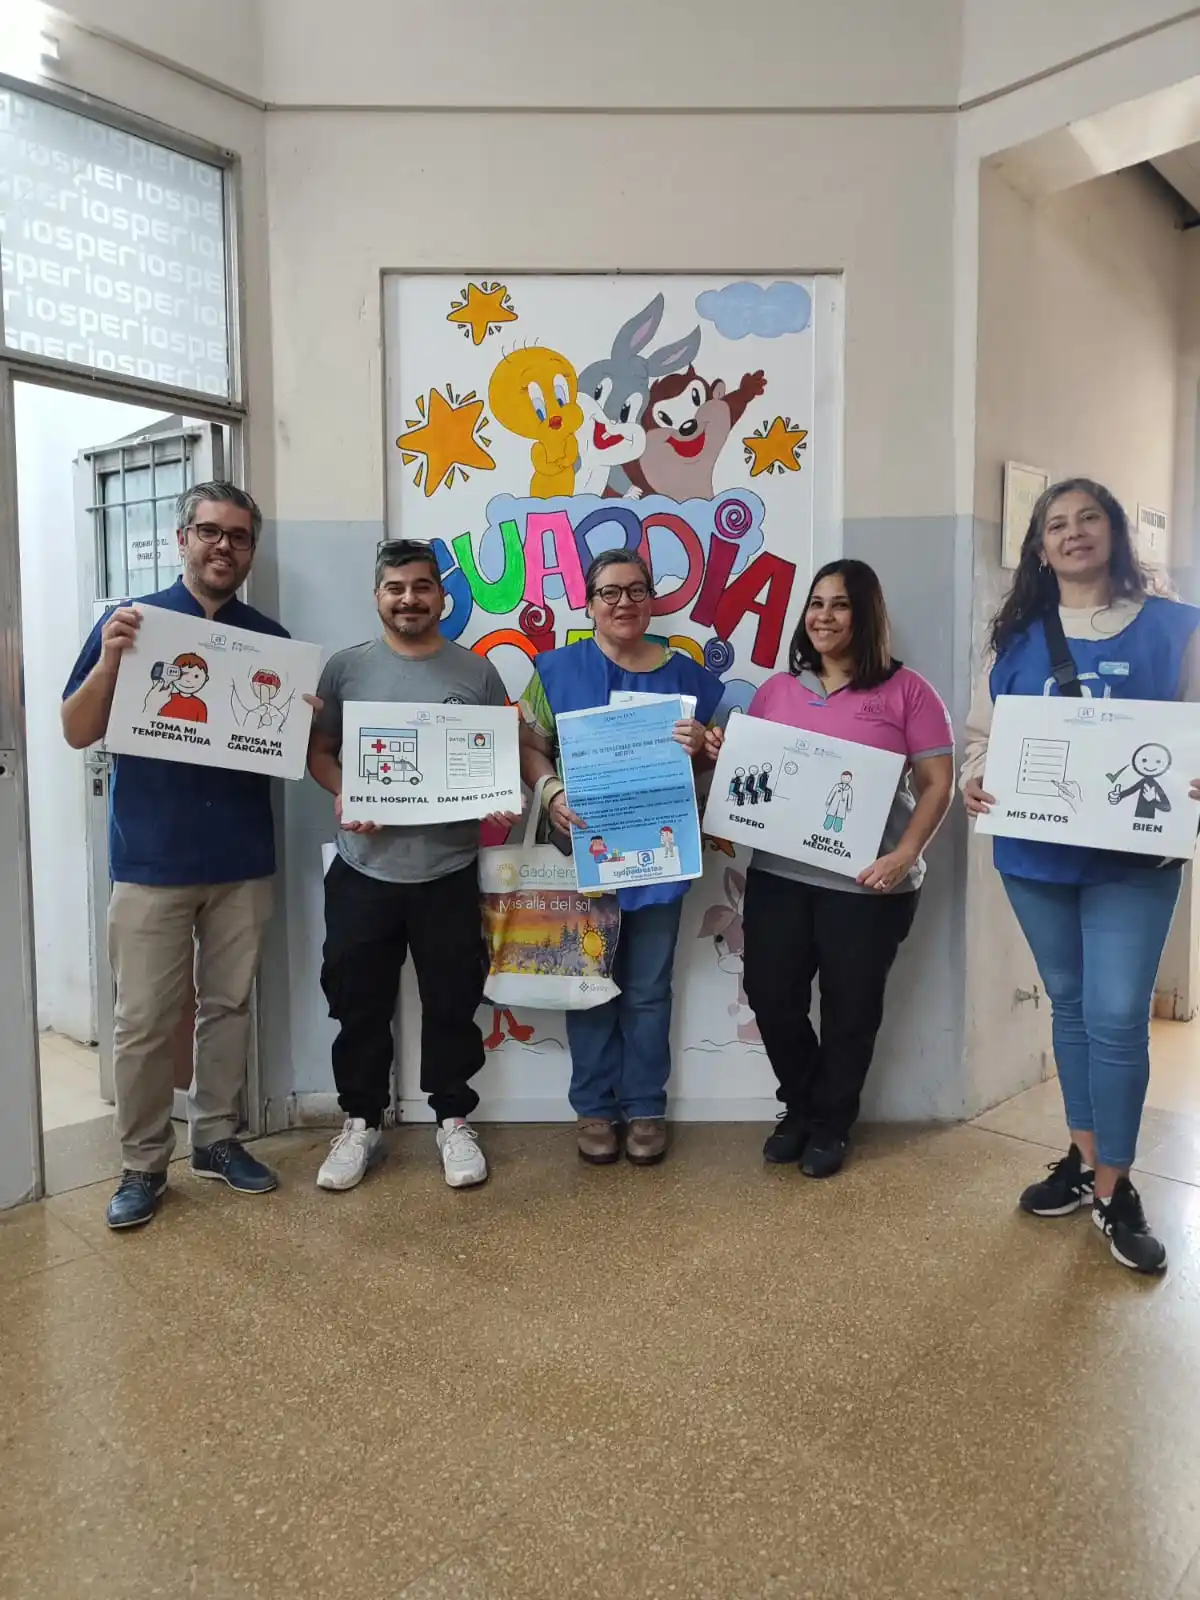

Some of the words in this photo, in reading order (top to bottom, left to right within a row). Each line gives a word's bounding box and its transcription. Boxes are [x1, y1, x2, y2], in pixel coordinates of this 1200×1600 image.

[150, 720, 180, 733] TOMA
[184, 724, 197, 735] MI
[131, 726, 211, 746] TEMPERATURA
[230, 733, 268, 747] REVISA
[269, 738, 282, 749] MI
[227, 742, 283, 757] GARGANTA
[380, 796, 430, 804] HOSPITAL
[437, 796, 459, 804] DAN
[461, 794, 478, 803] MIS
[480, 790, 513, 800] DATOS
[729, 814, 765, 829] ESPERO
[1006, 810, 1027, 819] MIS
[1029, 812, 1069, 824] DATOS
[1132, 822, 1163, 834] BIEN
[810, 833, 831, 845] QUE
[833, 840, 845, 849] EL
[525, 896, 546, 913] allá
[550, 896, 571, 912] del
[575, 898, 591, 912] sol
